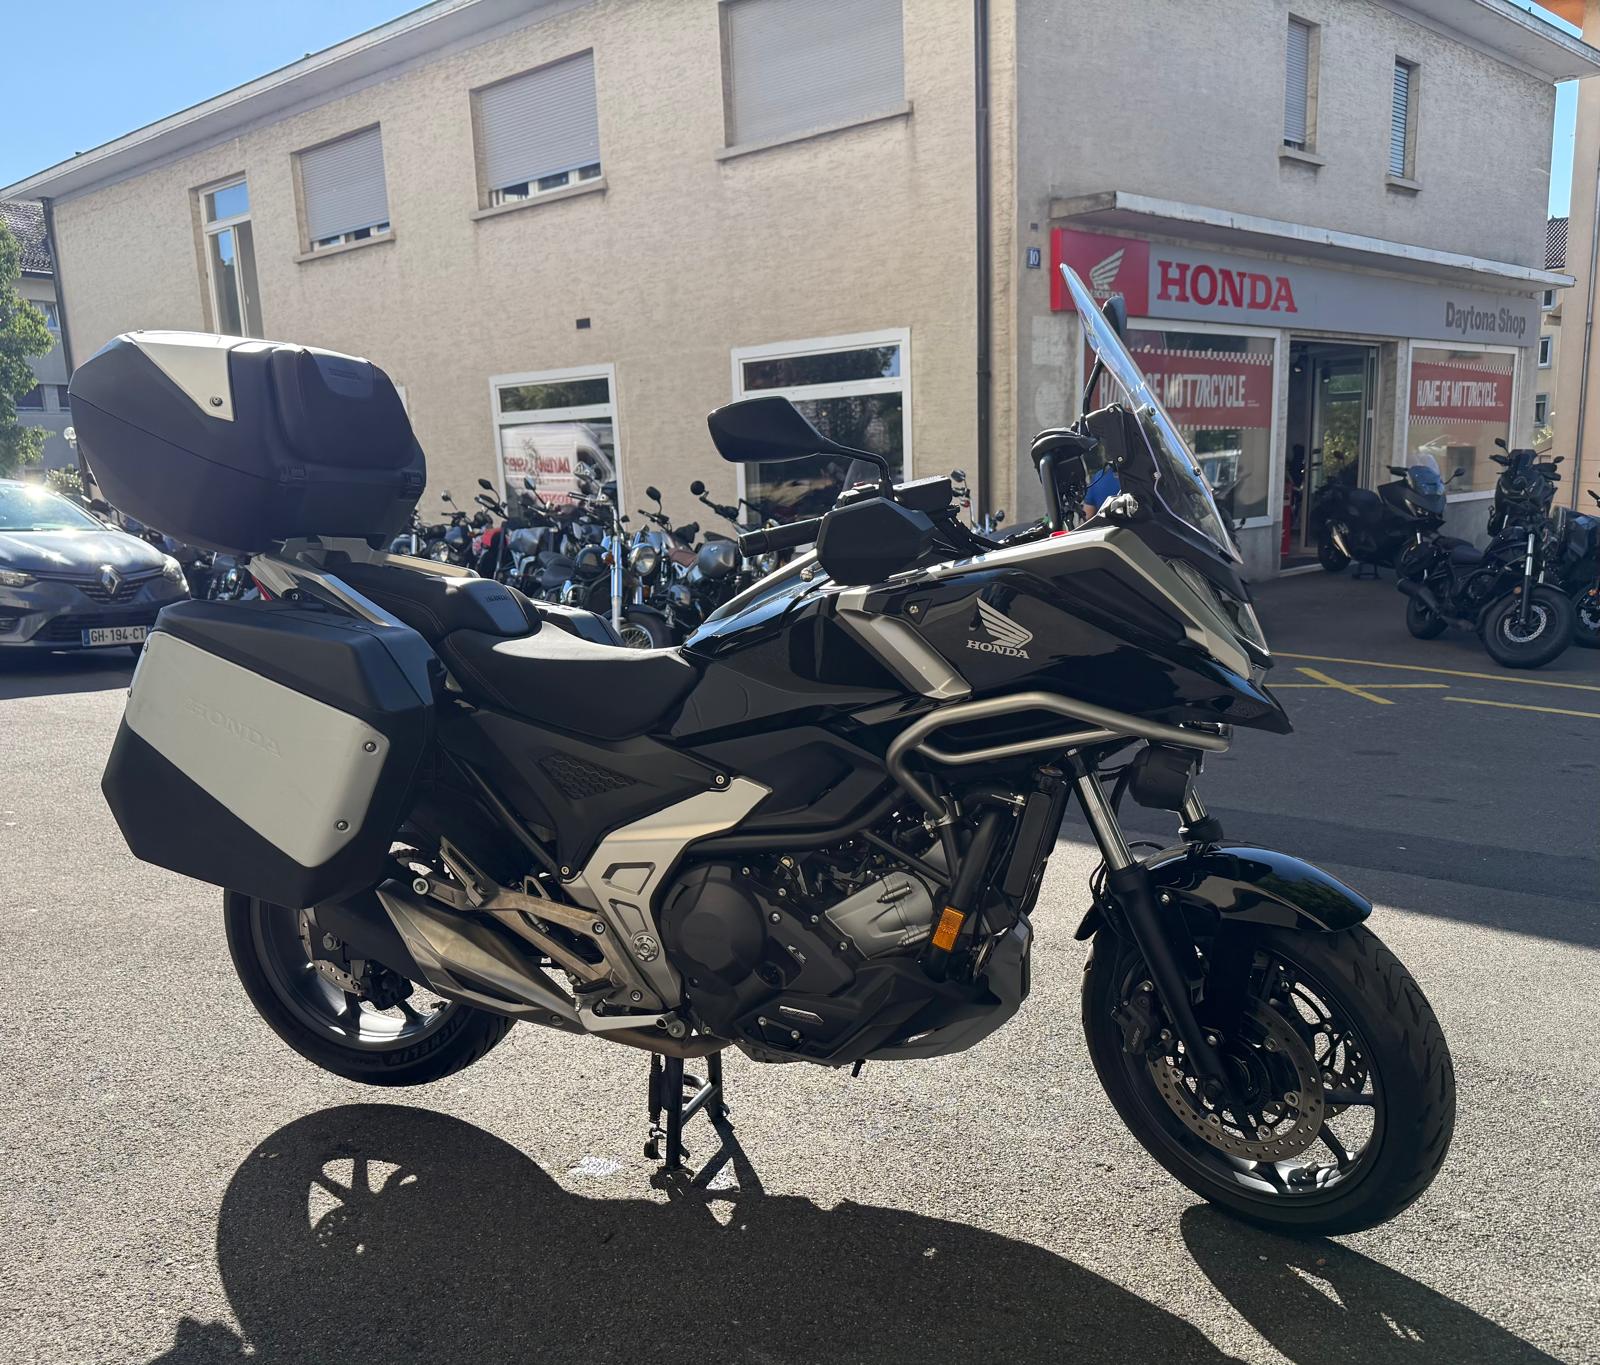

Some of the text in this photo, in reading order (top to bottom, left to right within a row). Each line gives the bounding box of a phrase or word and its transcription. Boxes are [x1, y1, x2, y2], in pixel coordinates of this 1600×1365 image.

[1029, 250, 1039, 265] 10
[1157, 260, 1298, 313] HONDA
[1445, 301, 1526, 339] Daytona Shop
[1416, 379, 1440, 407] HOME
[1440, 380, 1451, 407] OF
[90, 627, 145, 642] GH-194-CT
[966, 639, 1030, 659] HONDA
[183, 696, 281, 758] HONDA
